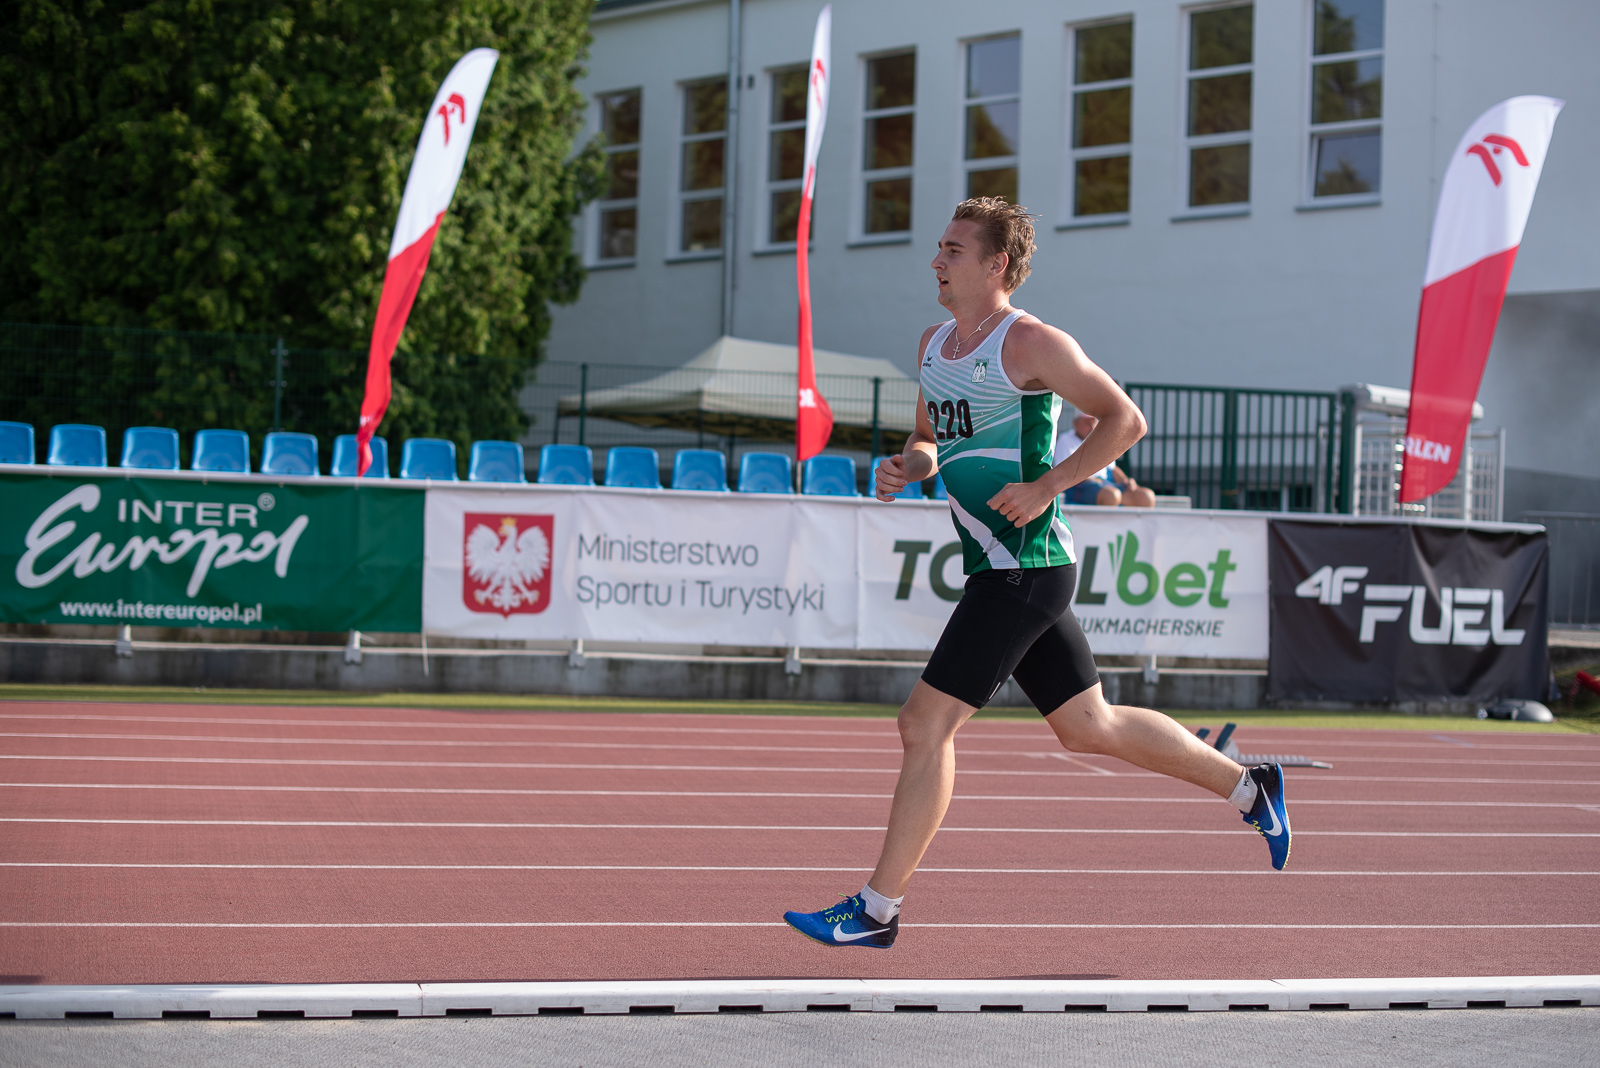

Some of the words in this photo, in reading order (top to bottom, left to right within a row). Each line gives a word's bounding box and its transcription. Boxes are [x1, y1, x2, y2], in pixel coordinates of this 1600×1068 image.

[927, 398, 974, 440] 220
[15, 483, 309, 598] Europol
[577, 533, 759, 567] Ministerstwo
[893, 530, 1237, 609] TOLbet
[1295, 565, 1369, 605] 4F
[59, 600, 263, 622] www.intereuropol.pl
[576, 576, 672, 610] Sportu
[680, 579, 687, 606] i
[696, 580, 825, 616] Turystyki
[1359, 584, 1526, 646] FUEL
[1076, 616, 1225, 638] UKMACHERSKIE
